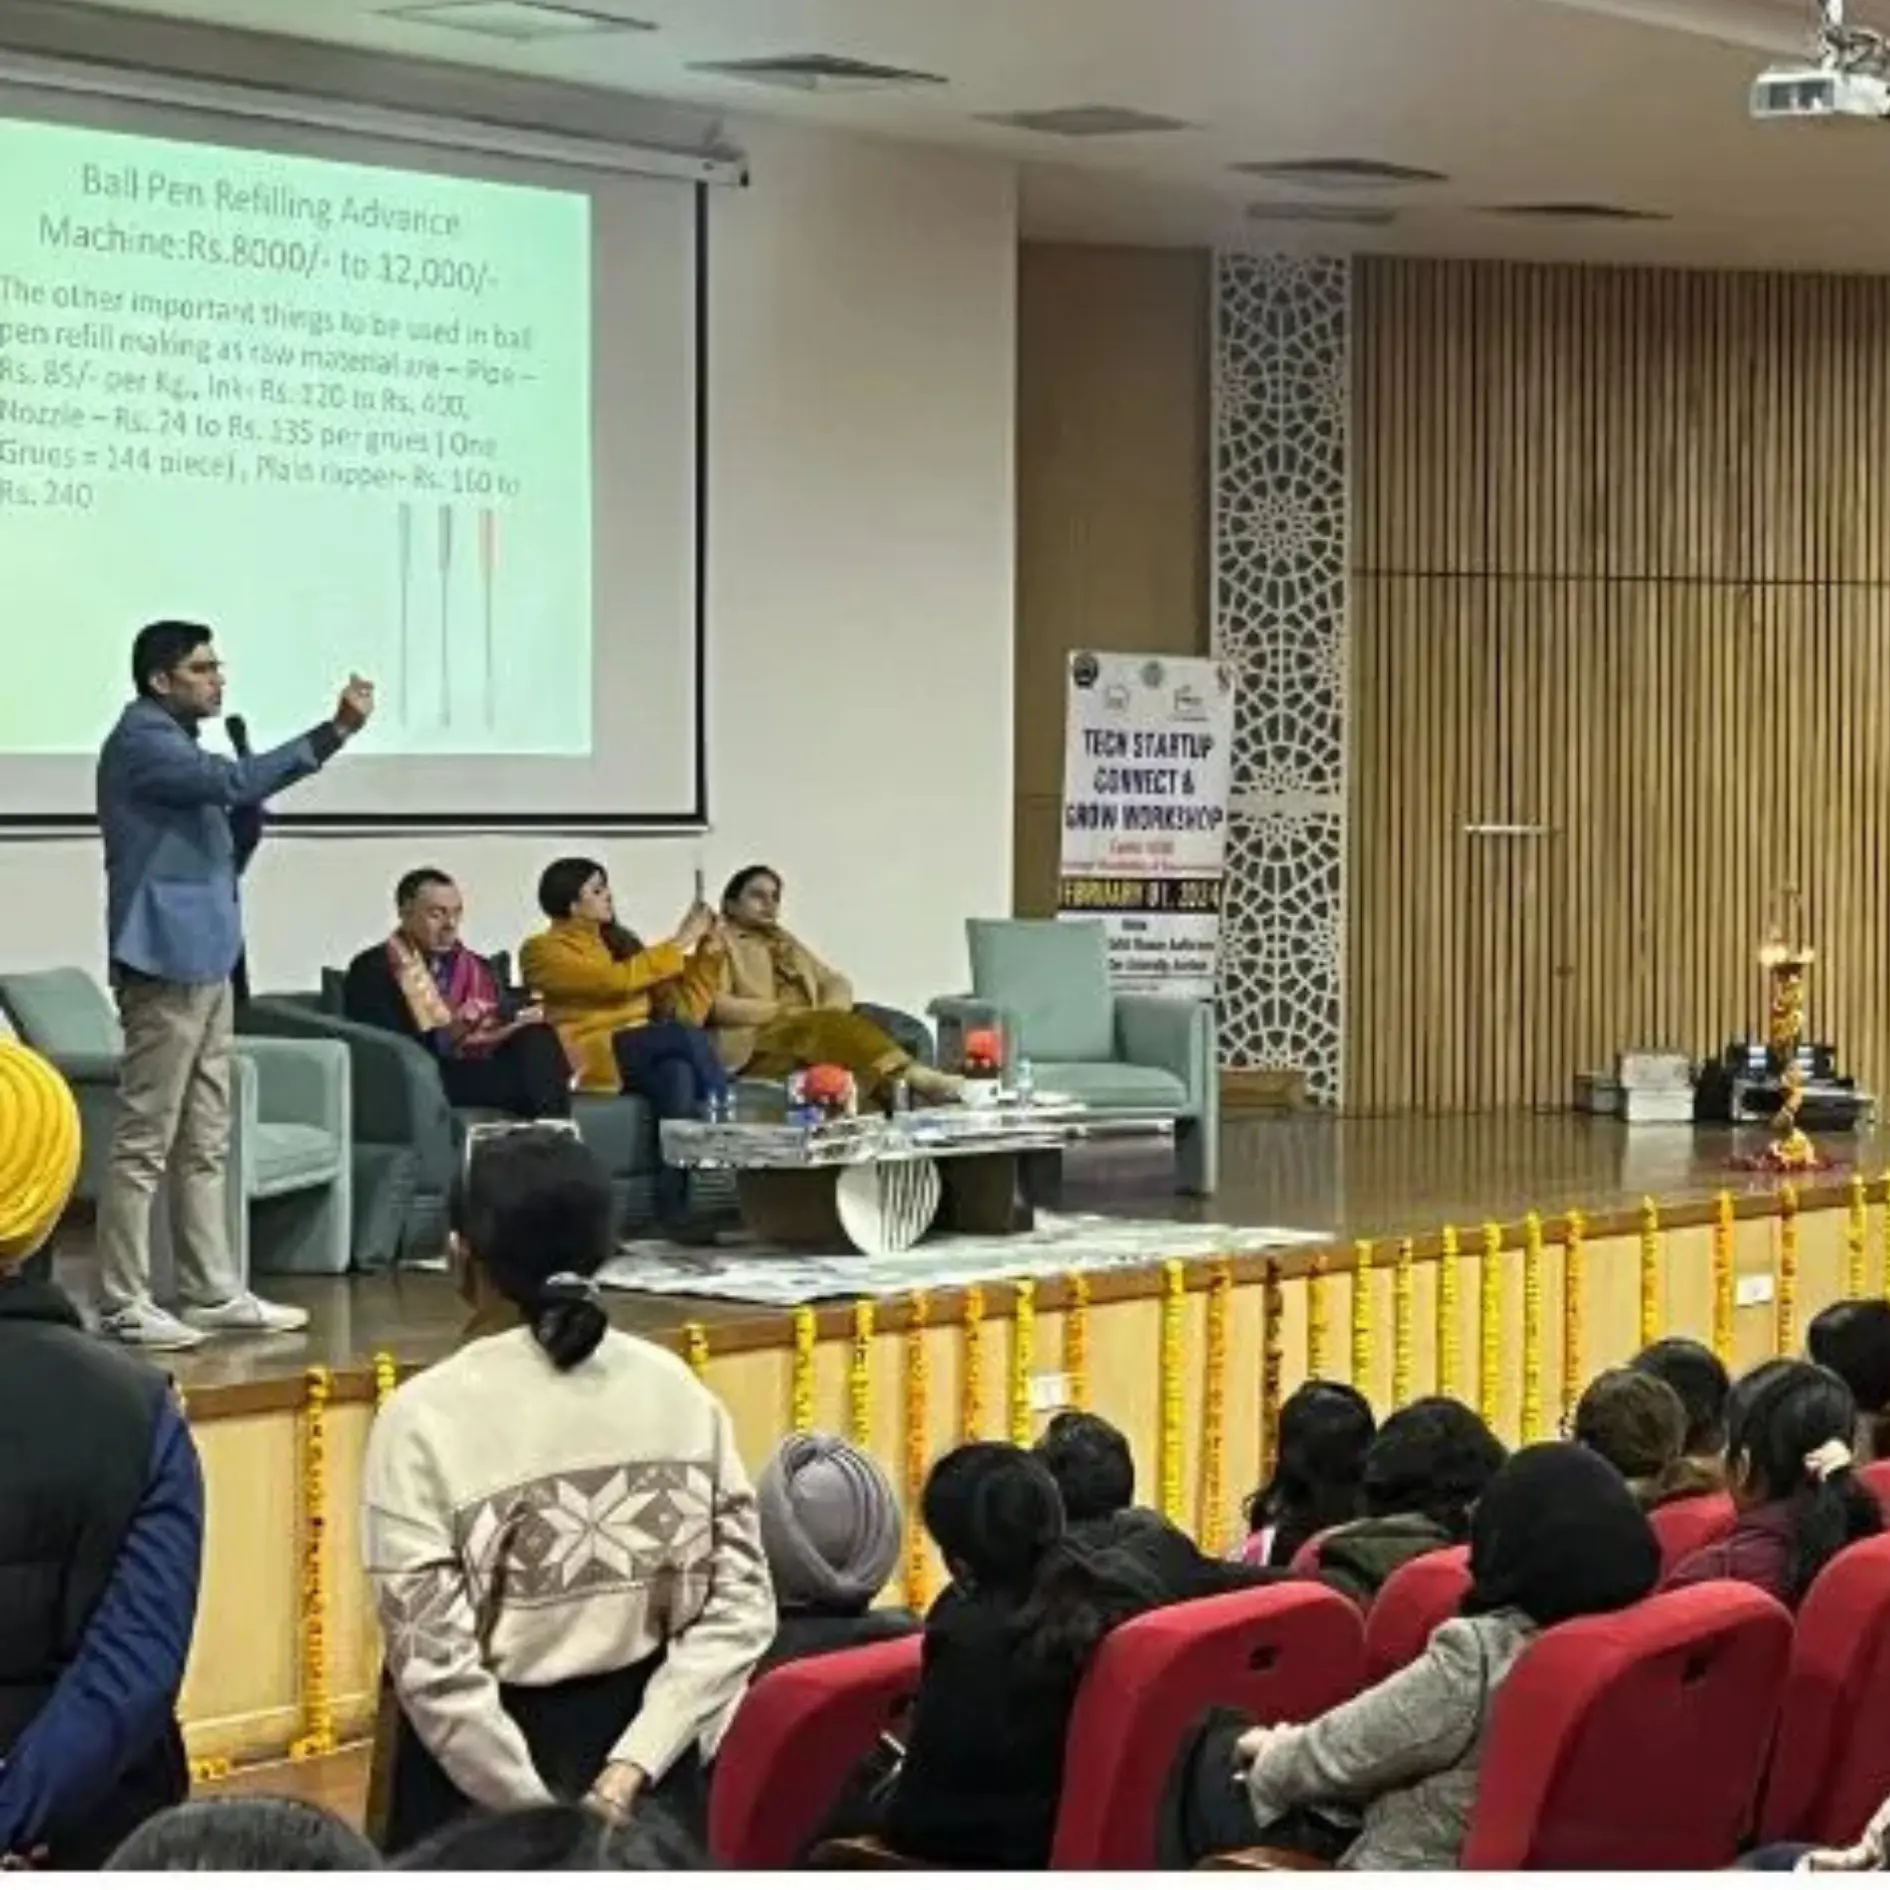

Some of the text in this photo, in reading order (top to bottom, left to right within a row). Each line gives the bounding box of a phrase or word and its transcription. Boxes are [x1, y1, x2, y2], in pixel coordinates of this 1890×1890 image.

[82, 163, 460, 237] Ball Pen Refilling Advance
[341, 250, 368, 280] to
[379, 252, 499, 295] 12,000/-
[0, 275, 45, 305] The
[52, 284, 123, 312] other
[132, 291, 254, 325] important
[261, 300, 333, 336] things
[340, 311, 366, 335] to
[373, 310, 401, 340] be
[467, 321, 488, 346] in
[0, 322, 49, 349] pen
[56, 322, 113, 352] refill
[120, 327, 211, 364] making
[302, 348, 398, 378] material
[196, 414, 221, 438] to
[1083, 728, 1216, 760] TECH STARTUP
[1093, 766, 1179, 795] CONNECT
[1064, 802, 1224, 831] GROW WORKSHOP
